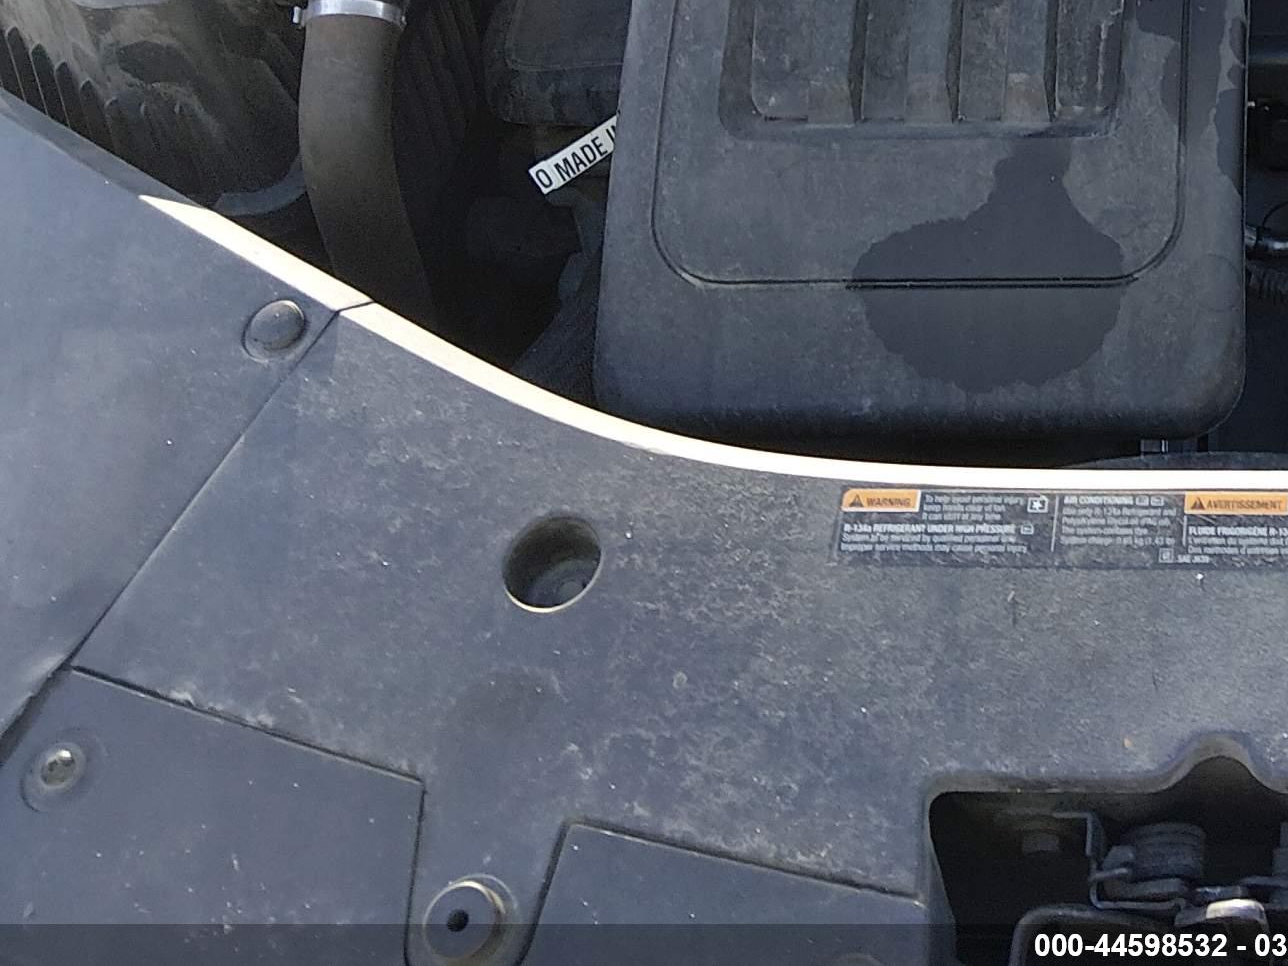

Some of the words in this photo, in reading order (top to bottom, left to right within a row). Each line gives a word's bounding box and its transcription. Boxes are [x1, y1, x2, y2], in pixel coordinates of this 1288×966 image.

[554, 136, 608, 182] MADE
[866, 497, 911, 507] WARNING
[1064, 495, 1078, 505] AIR
[1079, 495, 1133, 505] CONDITIONING
[1206, 500, 1282, 510] AVERTISSEMENT
[873, 523, 926, 533] REFRIGERANT
[927, 523, 953, 533] UNDER
[955, 523, 974, 533] HIGH
[976, 523, 1015, 533] PRESSURE
